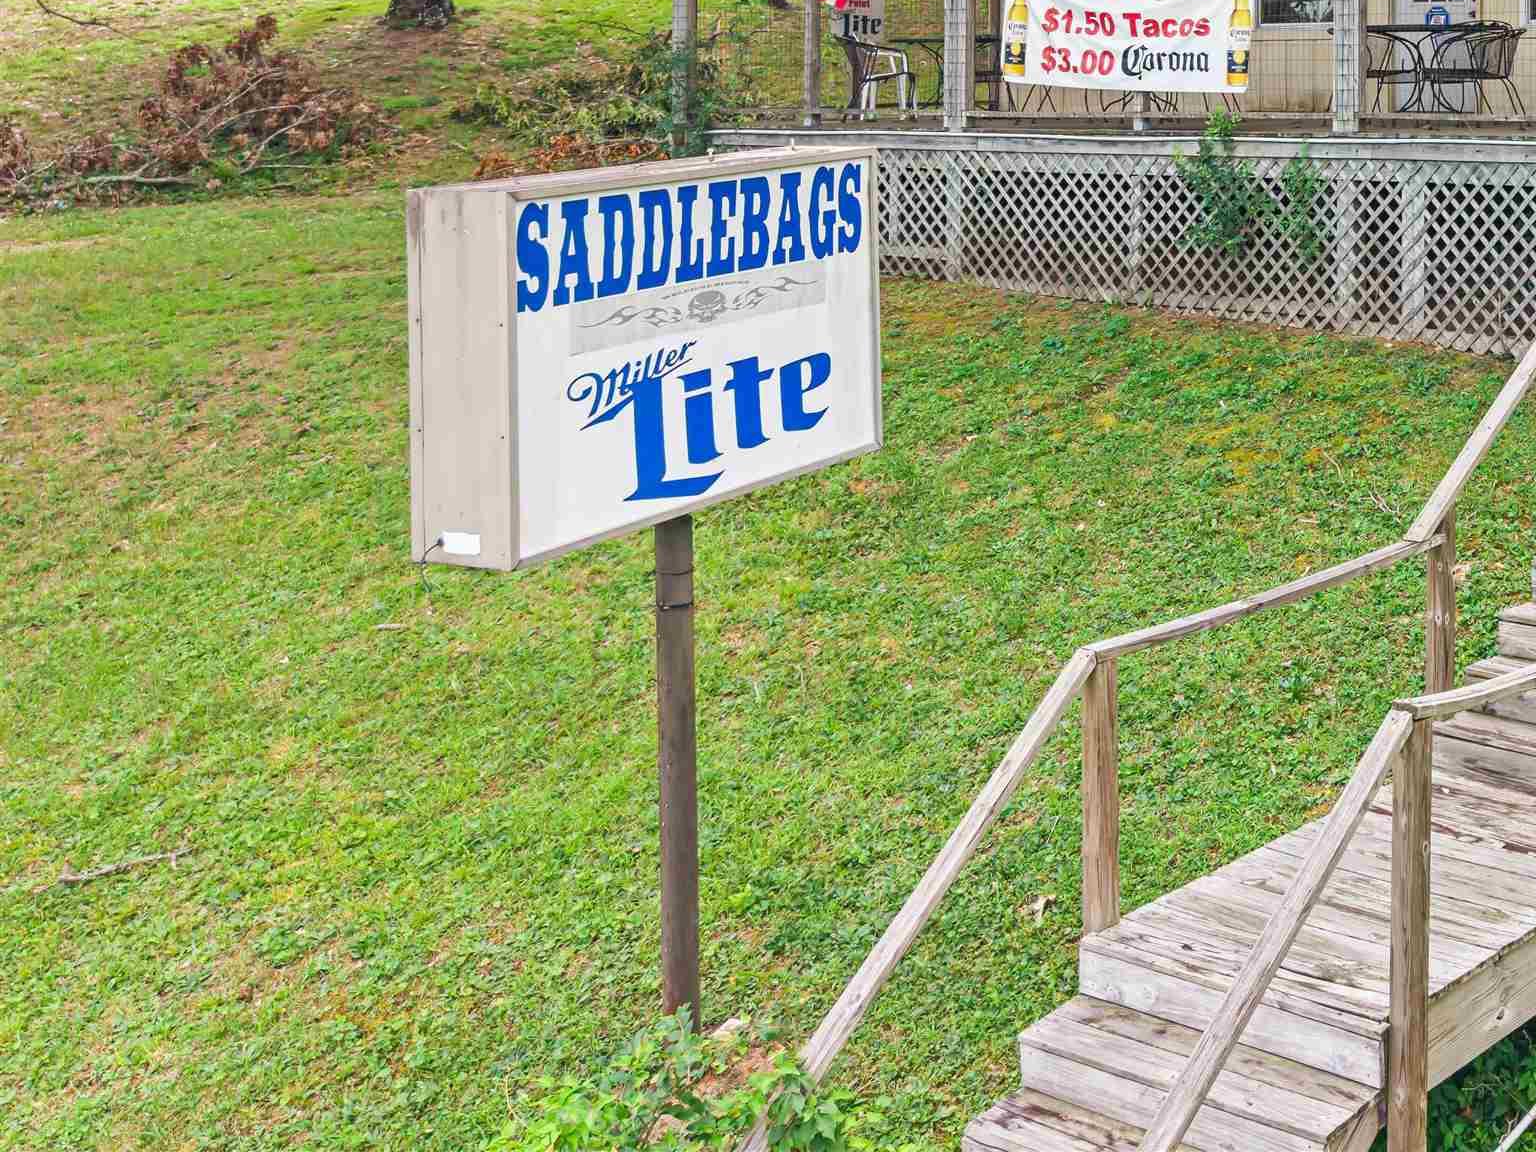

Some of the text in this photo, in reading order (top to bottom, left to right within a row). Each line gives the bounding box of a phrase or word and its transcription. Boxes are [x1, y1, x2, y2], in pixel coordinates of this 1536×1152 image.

[1041, 6, 1211, 38] $1.50 Tacos
[1041, 43, 1210, 80] $3.00 Corona
[517, 162, 864, 313] SADDLEBAGS
[567, 340, 698, 430] Miller
[622, 351, 831, 501] Lite
